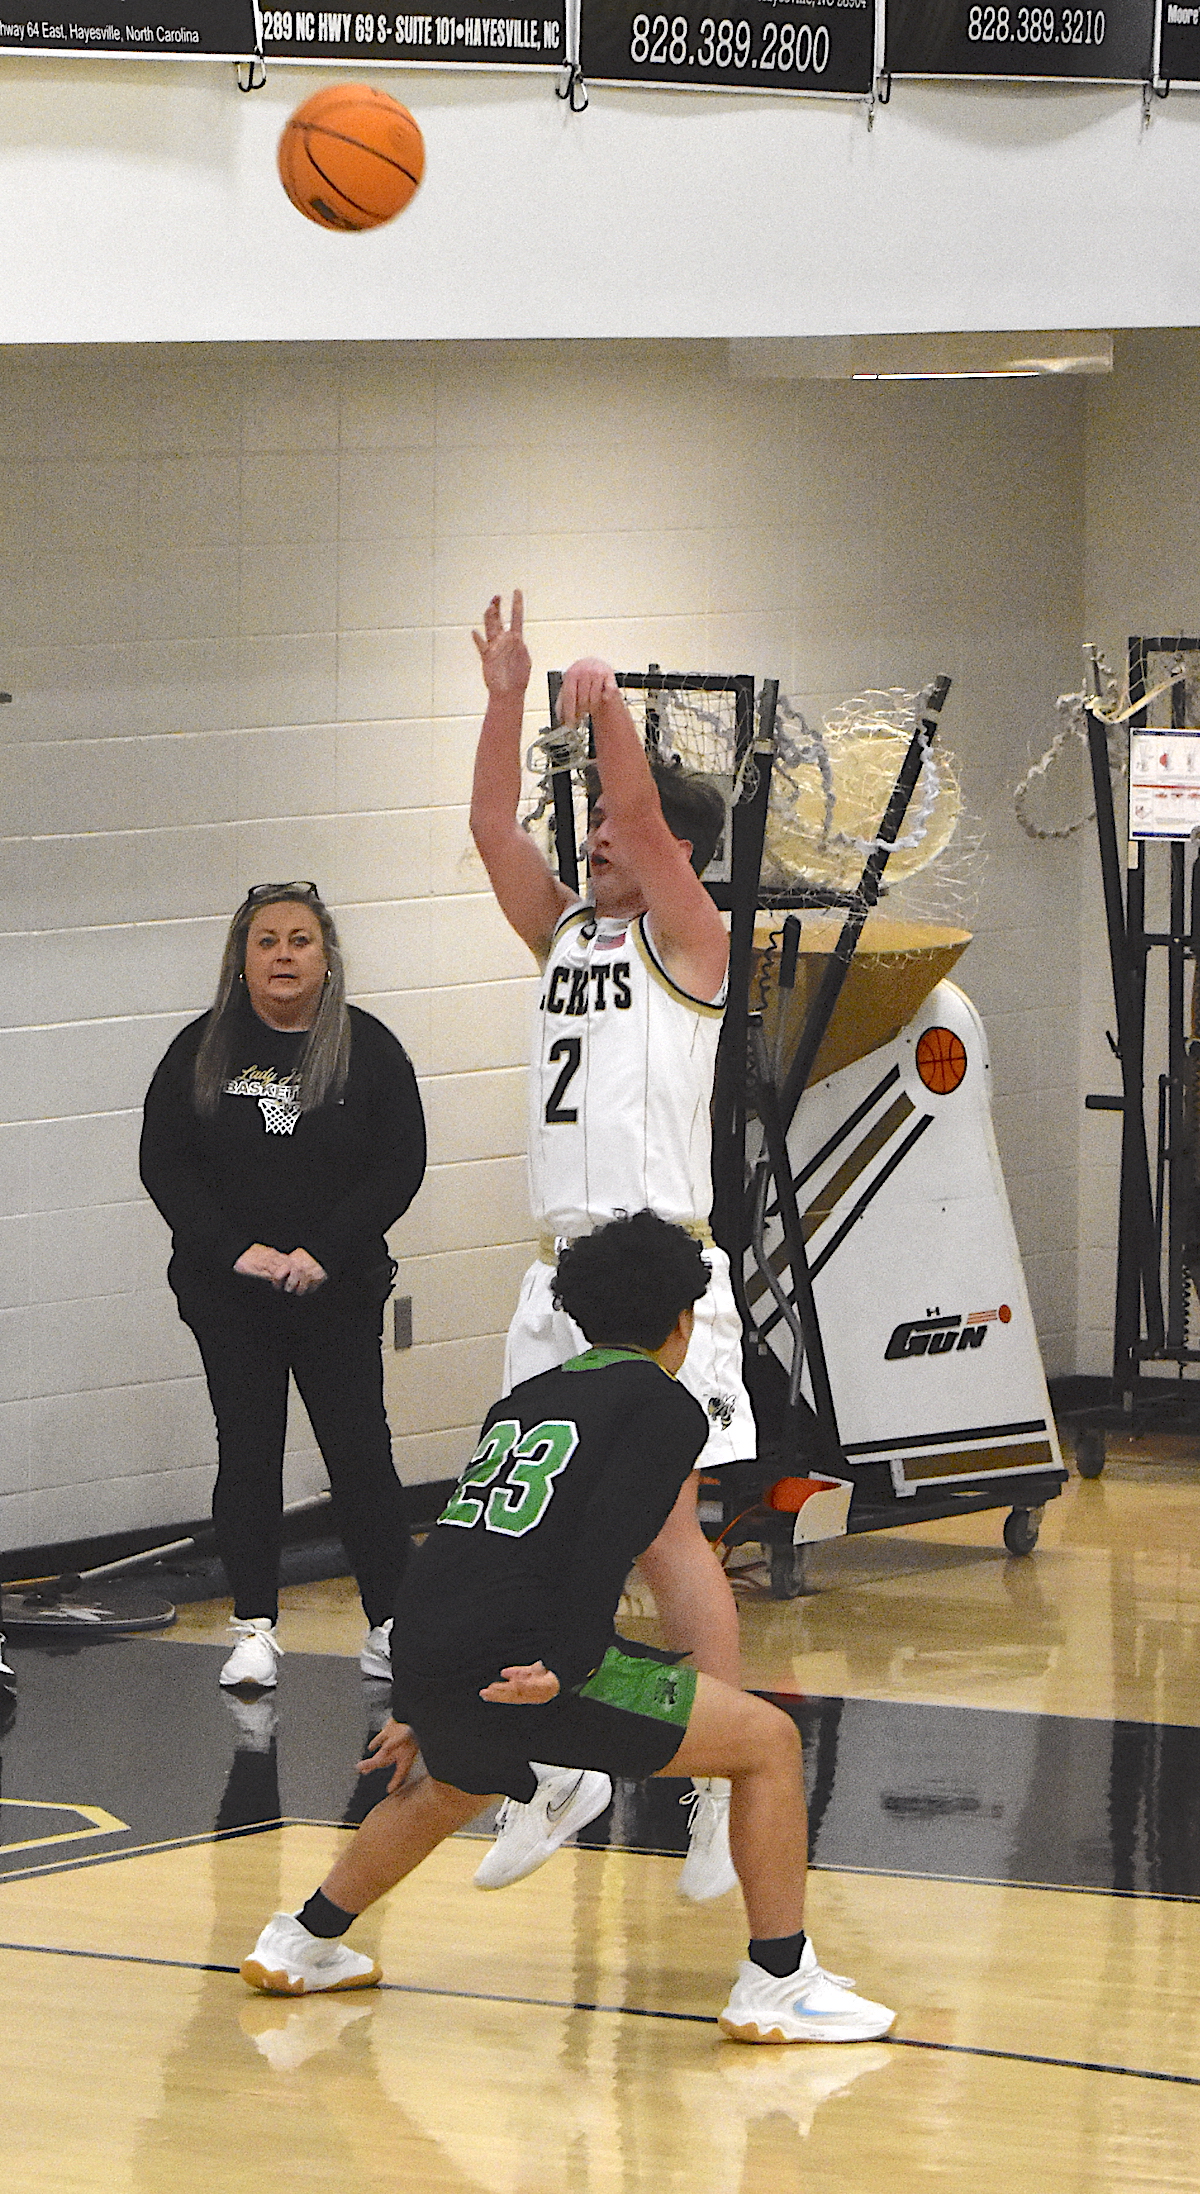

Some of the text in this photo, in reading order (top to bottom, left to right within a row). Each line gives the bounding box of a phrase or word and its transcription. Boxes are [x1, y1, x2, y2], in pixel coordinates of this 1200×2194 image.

[26, 21, 40, 38] 64
[42, 22, 68, 41] East,
[69, 23, 124, 43] Hayesville,
[126, 25, 154, 42] North
[156, 26, 200, 43] Carolina
[295, 11, 315, 42] NC
[318, 12, 352, 43] HWY
[355, 13, 375, 43] 69
[395, 14, 432, 45] SUITE
[543, 20, 560, 49] NC
[630, 13, 830, 74] 828.389.2800
[967, 5, 1106, 46] 828.389.3210
[540, 961, 632, 1016] CKTS
[235, 1064, 278, 1087] Lady
[545, 1037, 582, 1125] 2
[436, 1419, 581, 1538] 23
